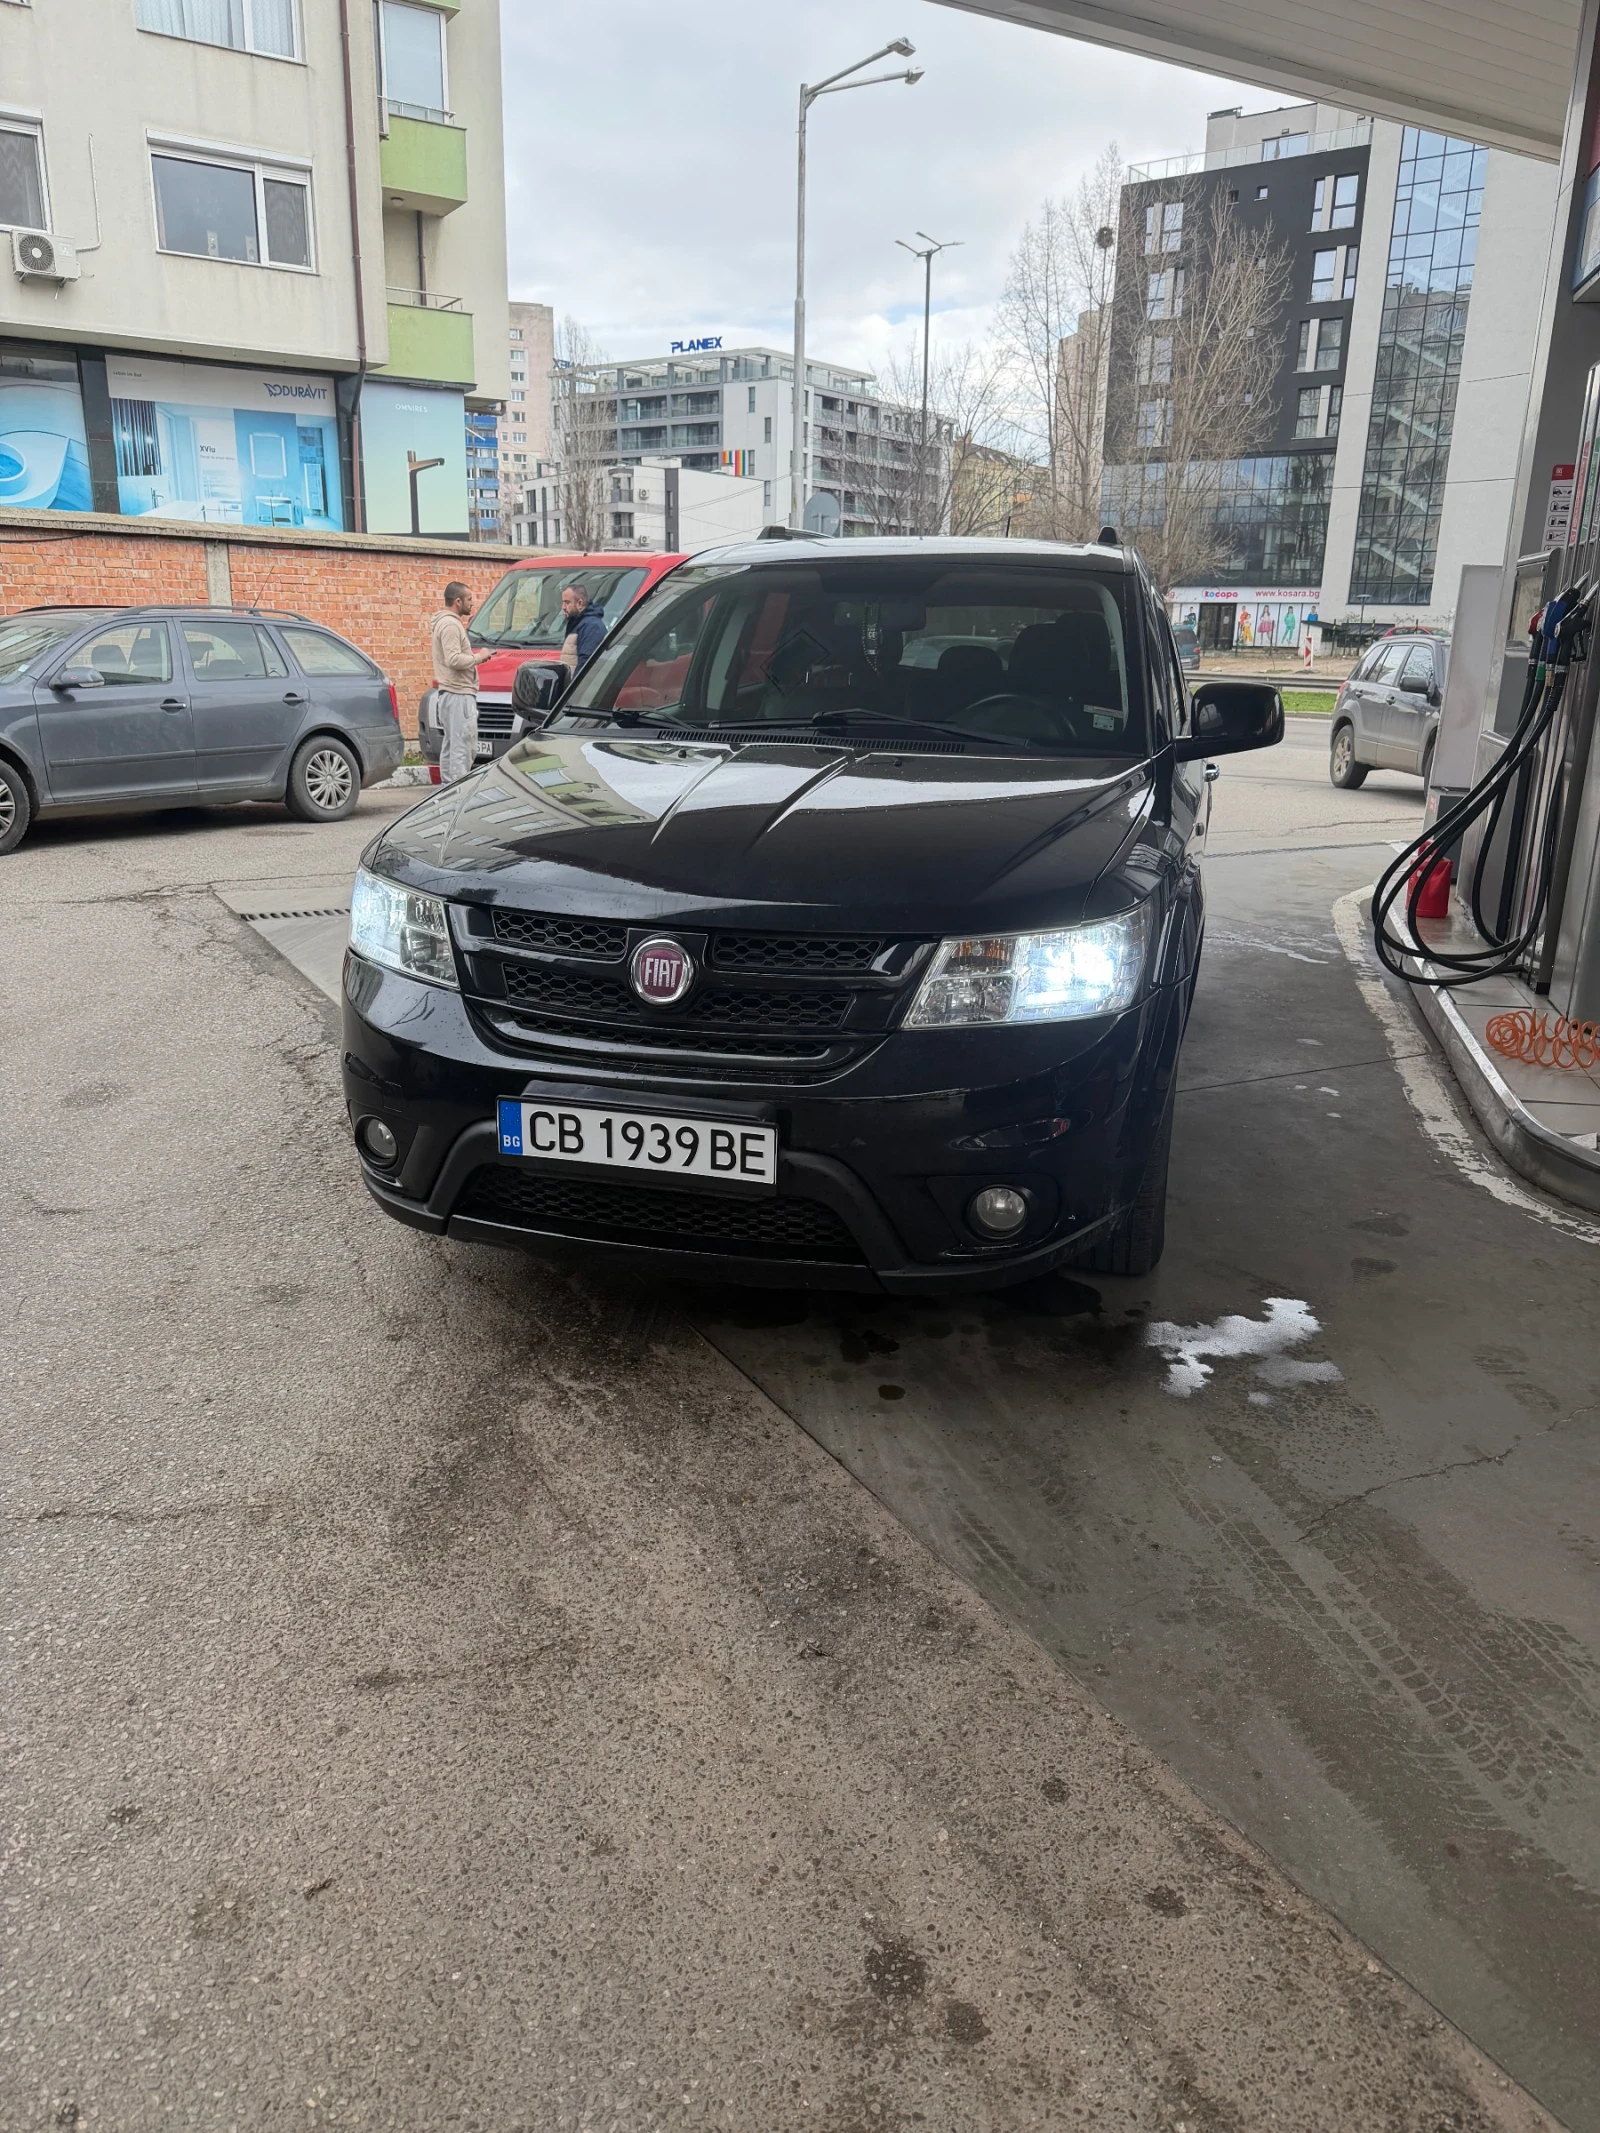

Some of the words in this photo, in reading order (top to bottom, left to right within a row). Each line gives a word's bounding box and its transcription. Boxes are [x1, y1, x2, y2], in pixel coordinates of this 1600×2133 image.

[670, 336, 723, 353] PLANEX
[282, 384, 327, 400] DURAVIT
[395, 403, 428, 413] OMNIRES
[1255, 589, 1320, 600] www.kosara.bg
[644, 957, 681, 988] FIAT
[503, 1134, 521, 1147] BG
